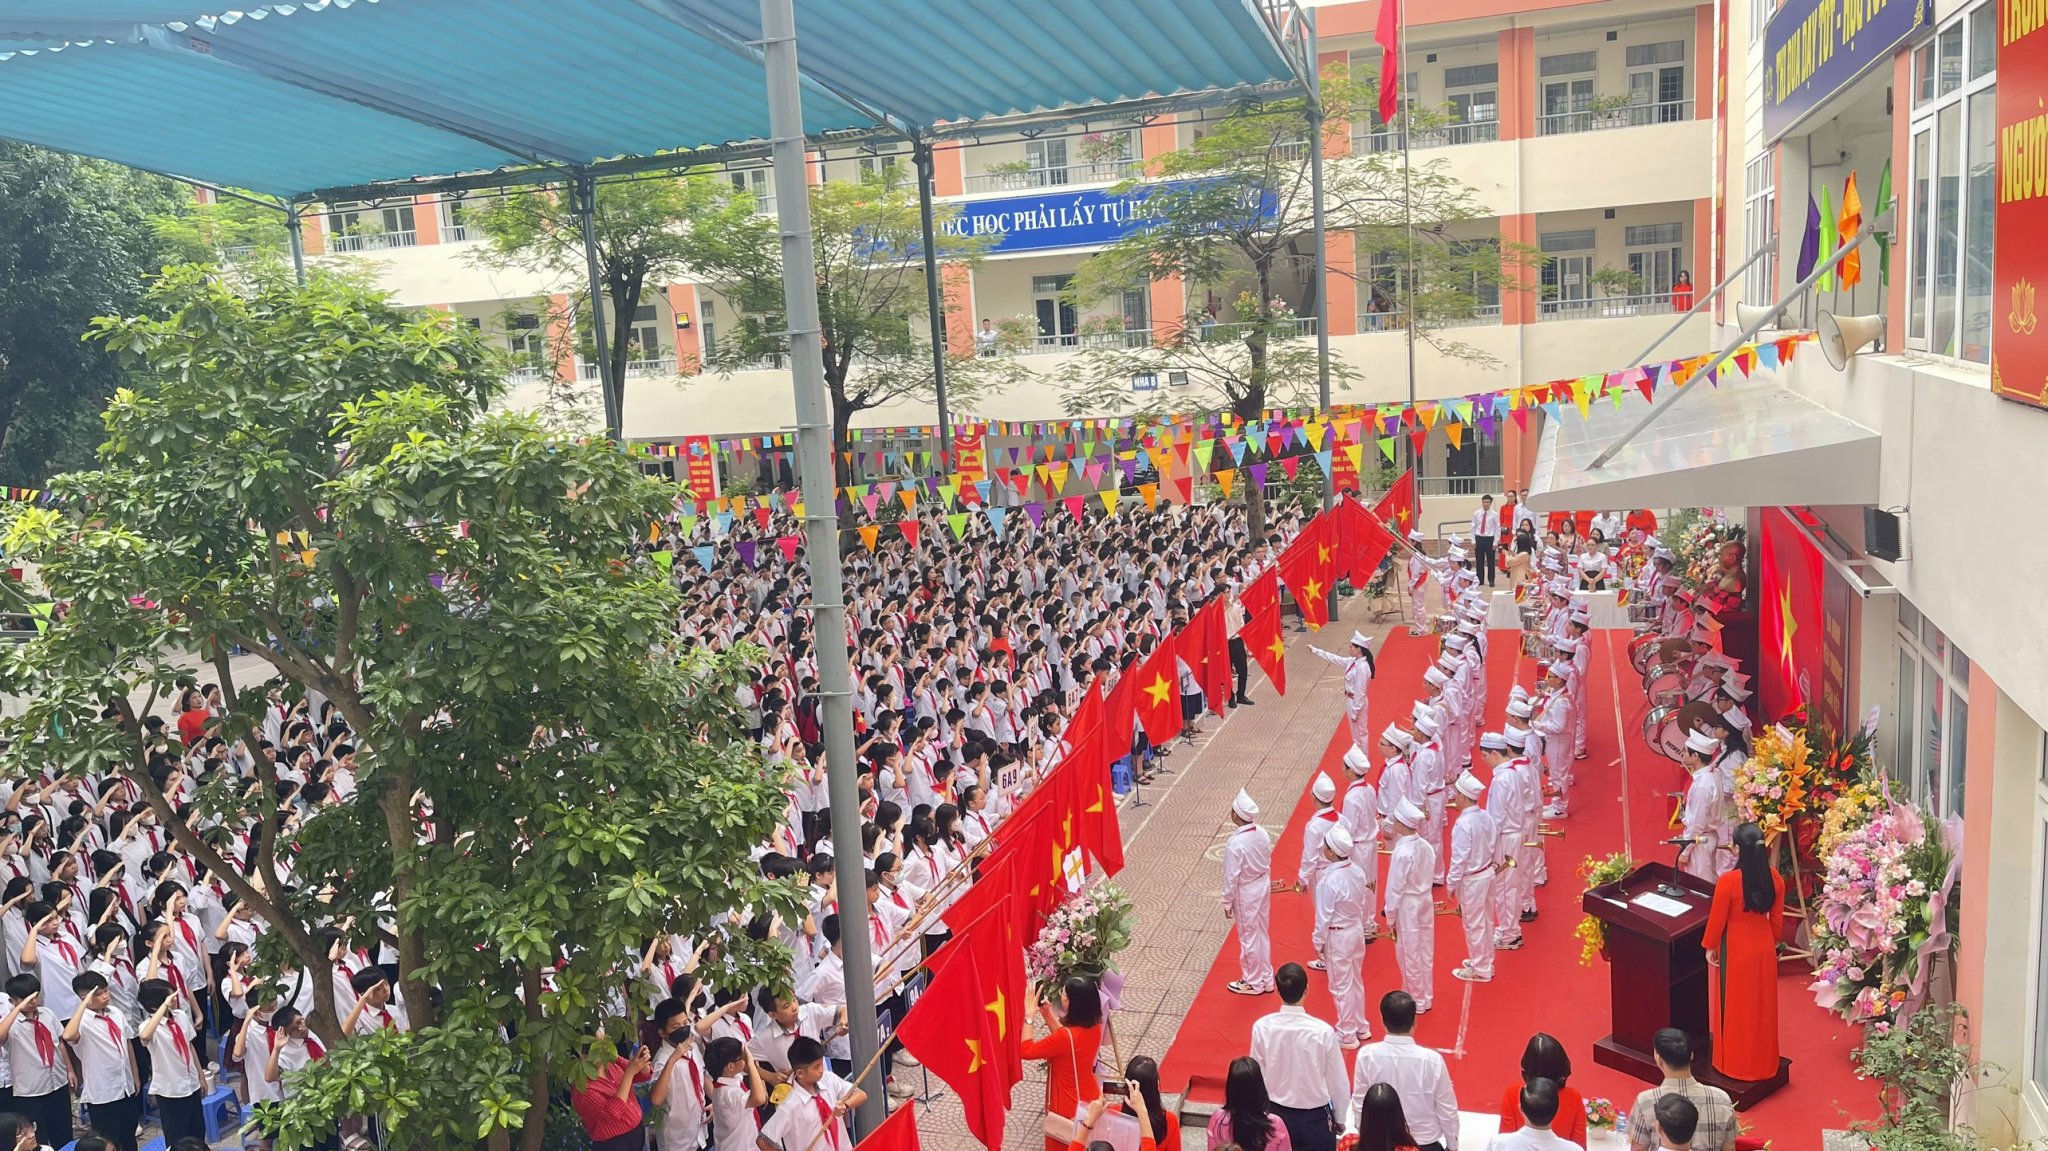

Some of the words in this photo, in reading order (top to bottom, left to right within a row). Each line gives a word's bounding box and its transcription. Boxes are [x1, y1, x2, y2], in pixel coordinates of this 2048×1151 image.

[972, 213, 1010, 239] HỌC
[1014, 203, 1058, 232] PHẢI
[1060, 196, 1096, 227] LẤY
[1100, 198, 1125, 227] TỰ
[1002, 769, 1018, 789] 6A9
